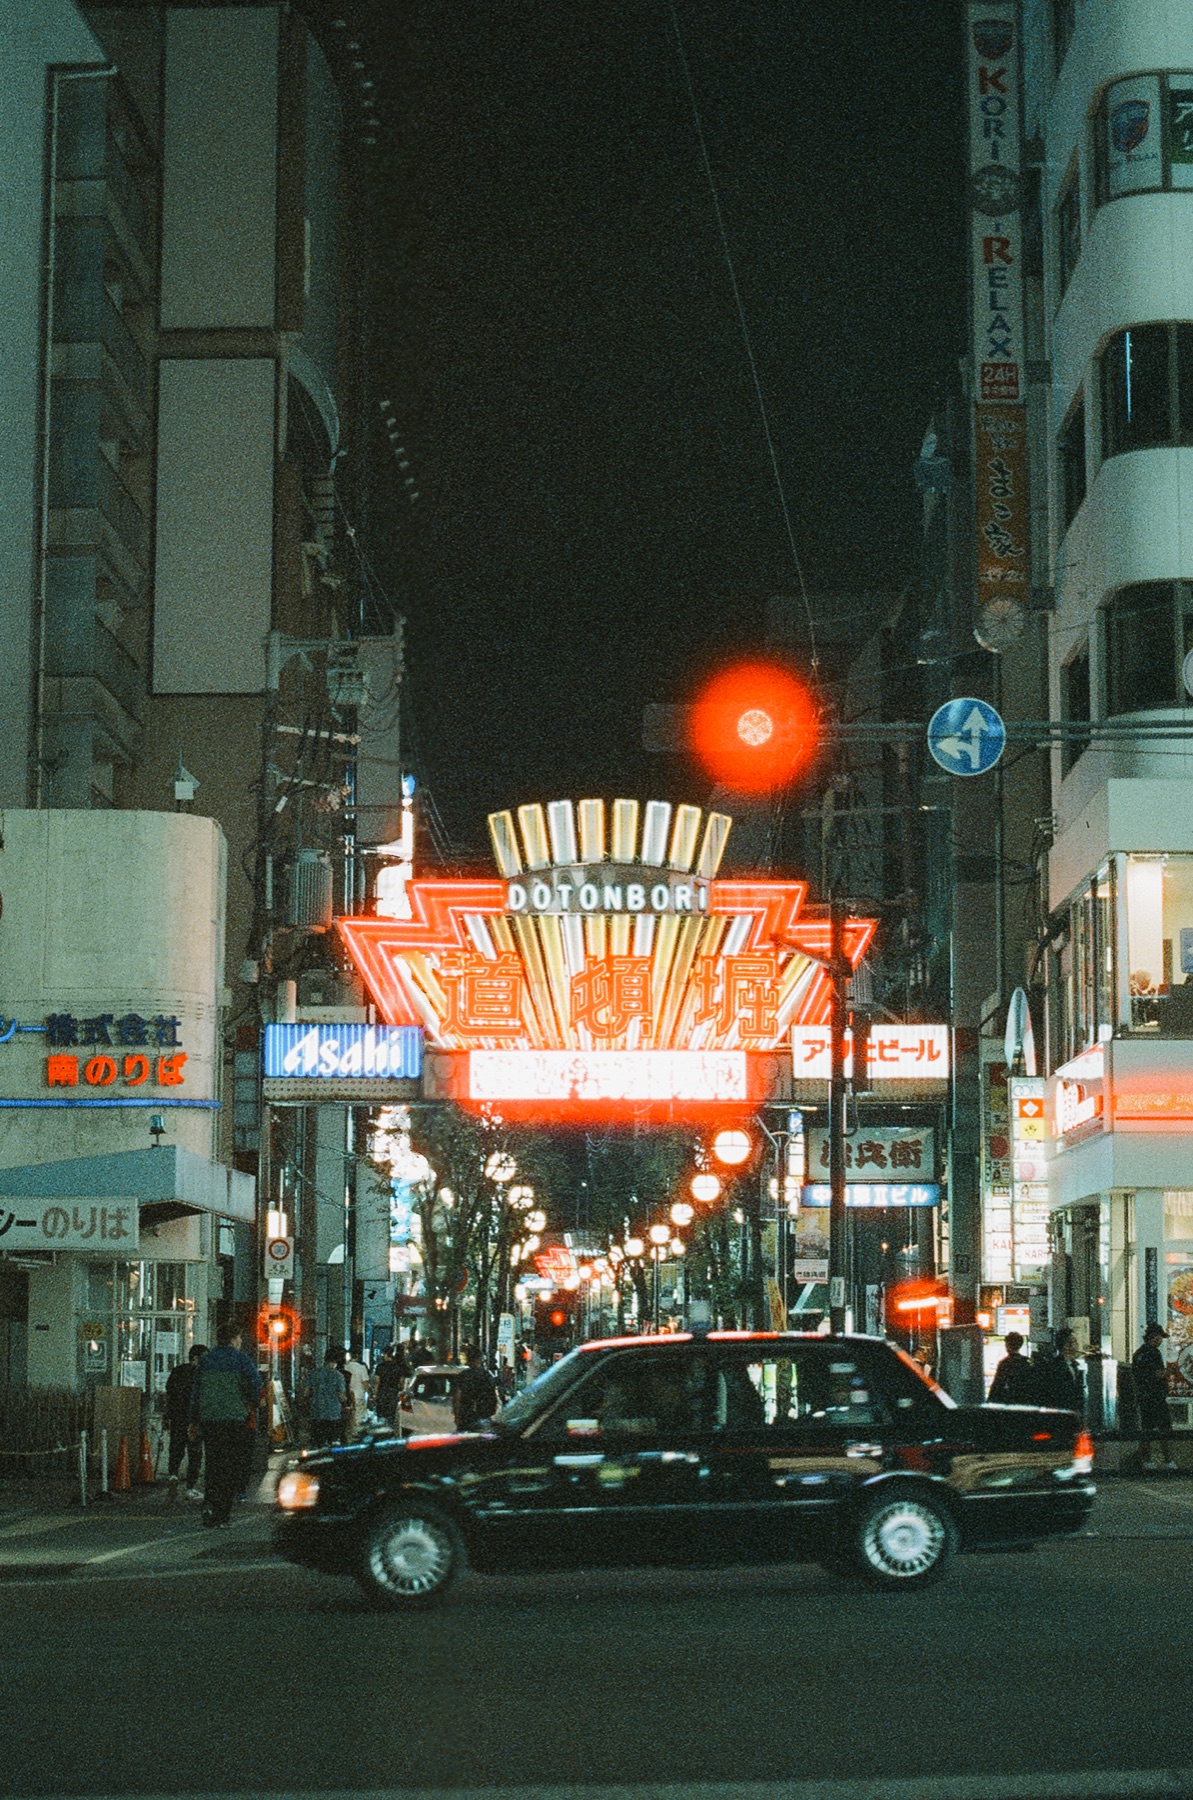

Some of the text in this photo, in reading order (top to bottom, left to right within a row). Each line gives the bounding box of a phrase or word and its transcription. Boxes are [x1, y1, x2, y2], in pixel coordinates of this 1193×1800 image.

[507, 883, 707, 912] DOTONBORI
[440, 951, 780, 1041] 道頓堀
[284, 1025, 402, 1073] Asahi
